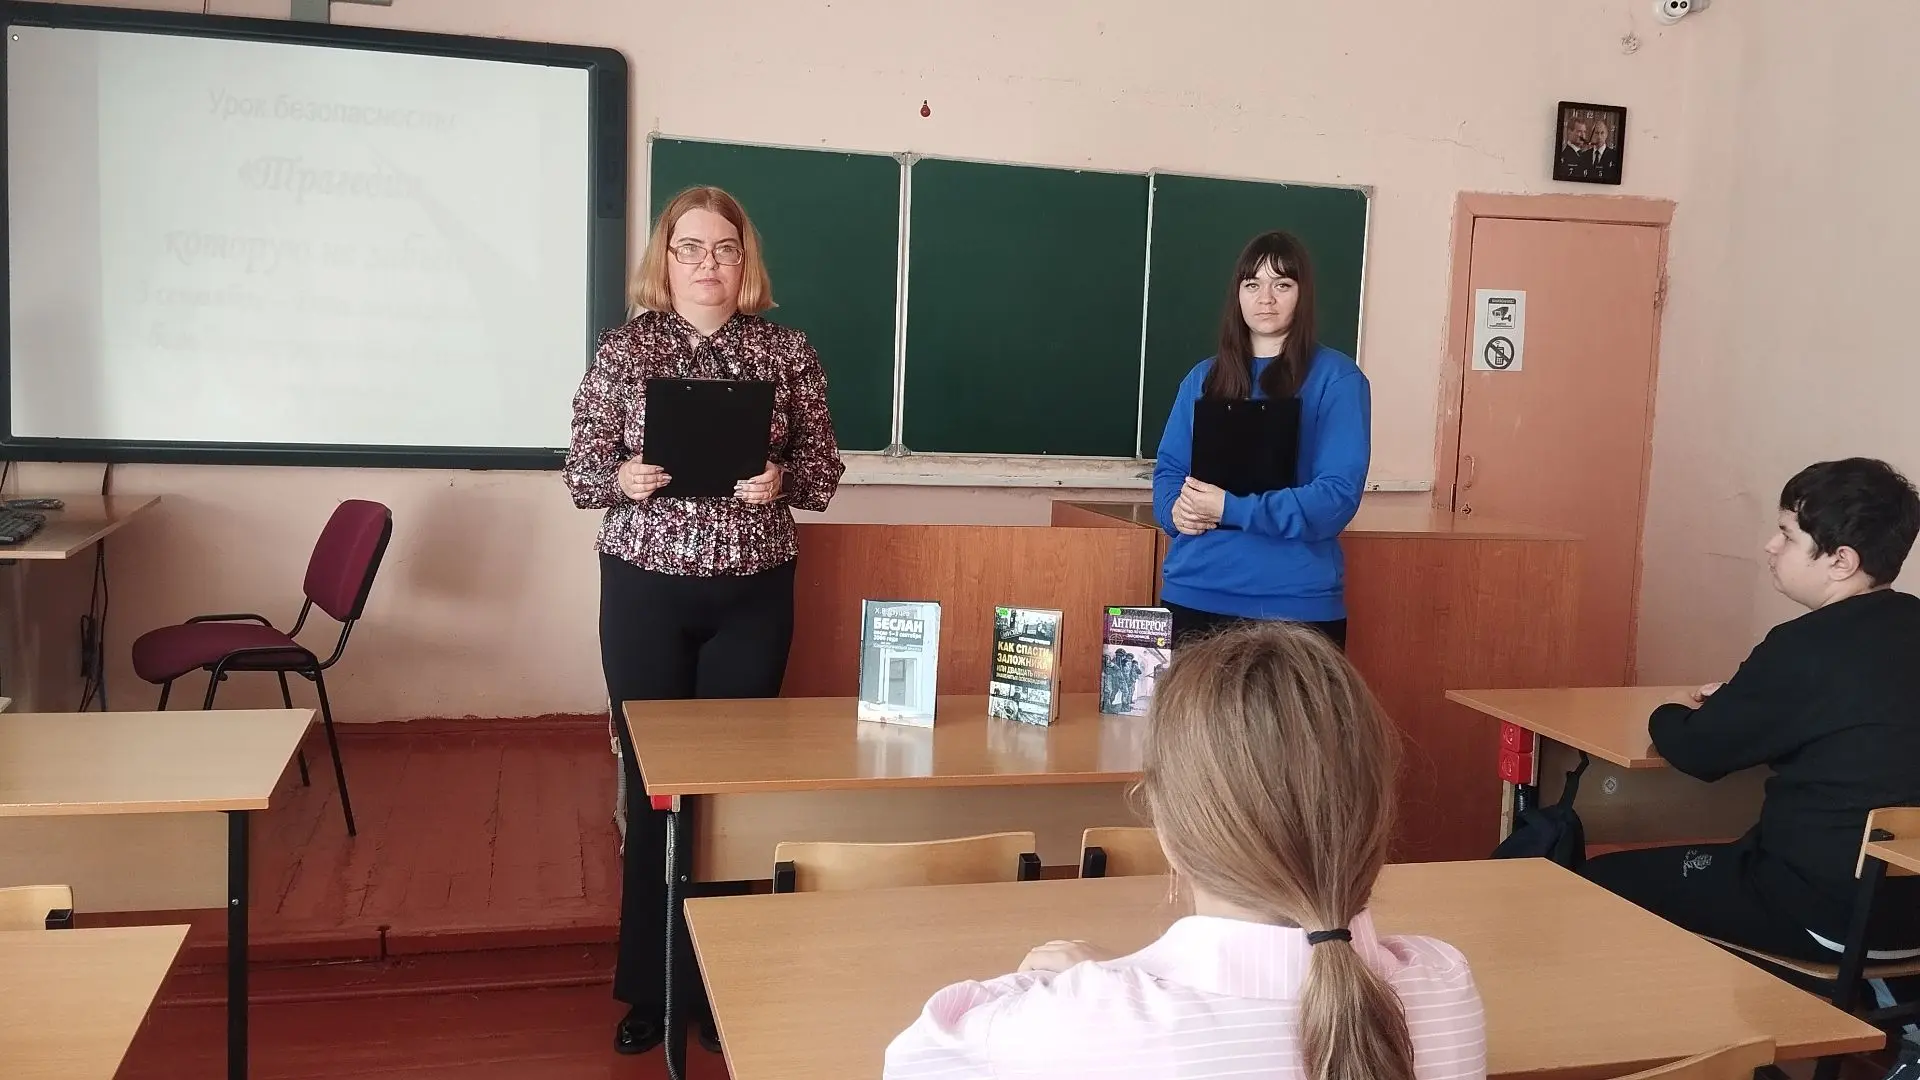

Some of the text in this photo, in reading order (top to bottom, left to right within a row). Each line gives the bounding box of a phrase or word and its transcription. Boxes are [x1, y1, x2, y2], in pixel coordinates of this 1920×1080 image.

[207, 86, 457, 132] Урок безопасности
[874, 617, 923, 633] БЕСЛАН
[1112, 616, 1166, 631] АНТИТЕРРОР
[998, 641, 1050, 658] КАК СПАСТИ
